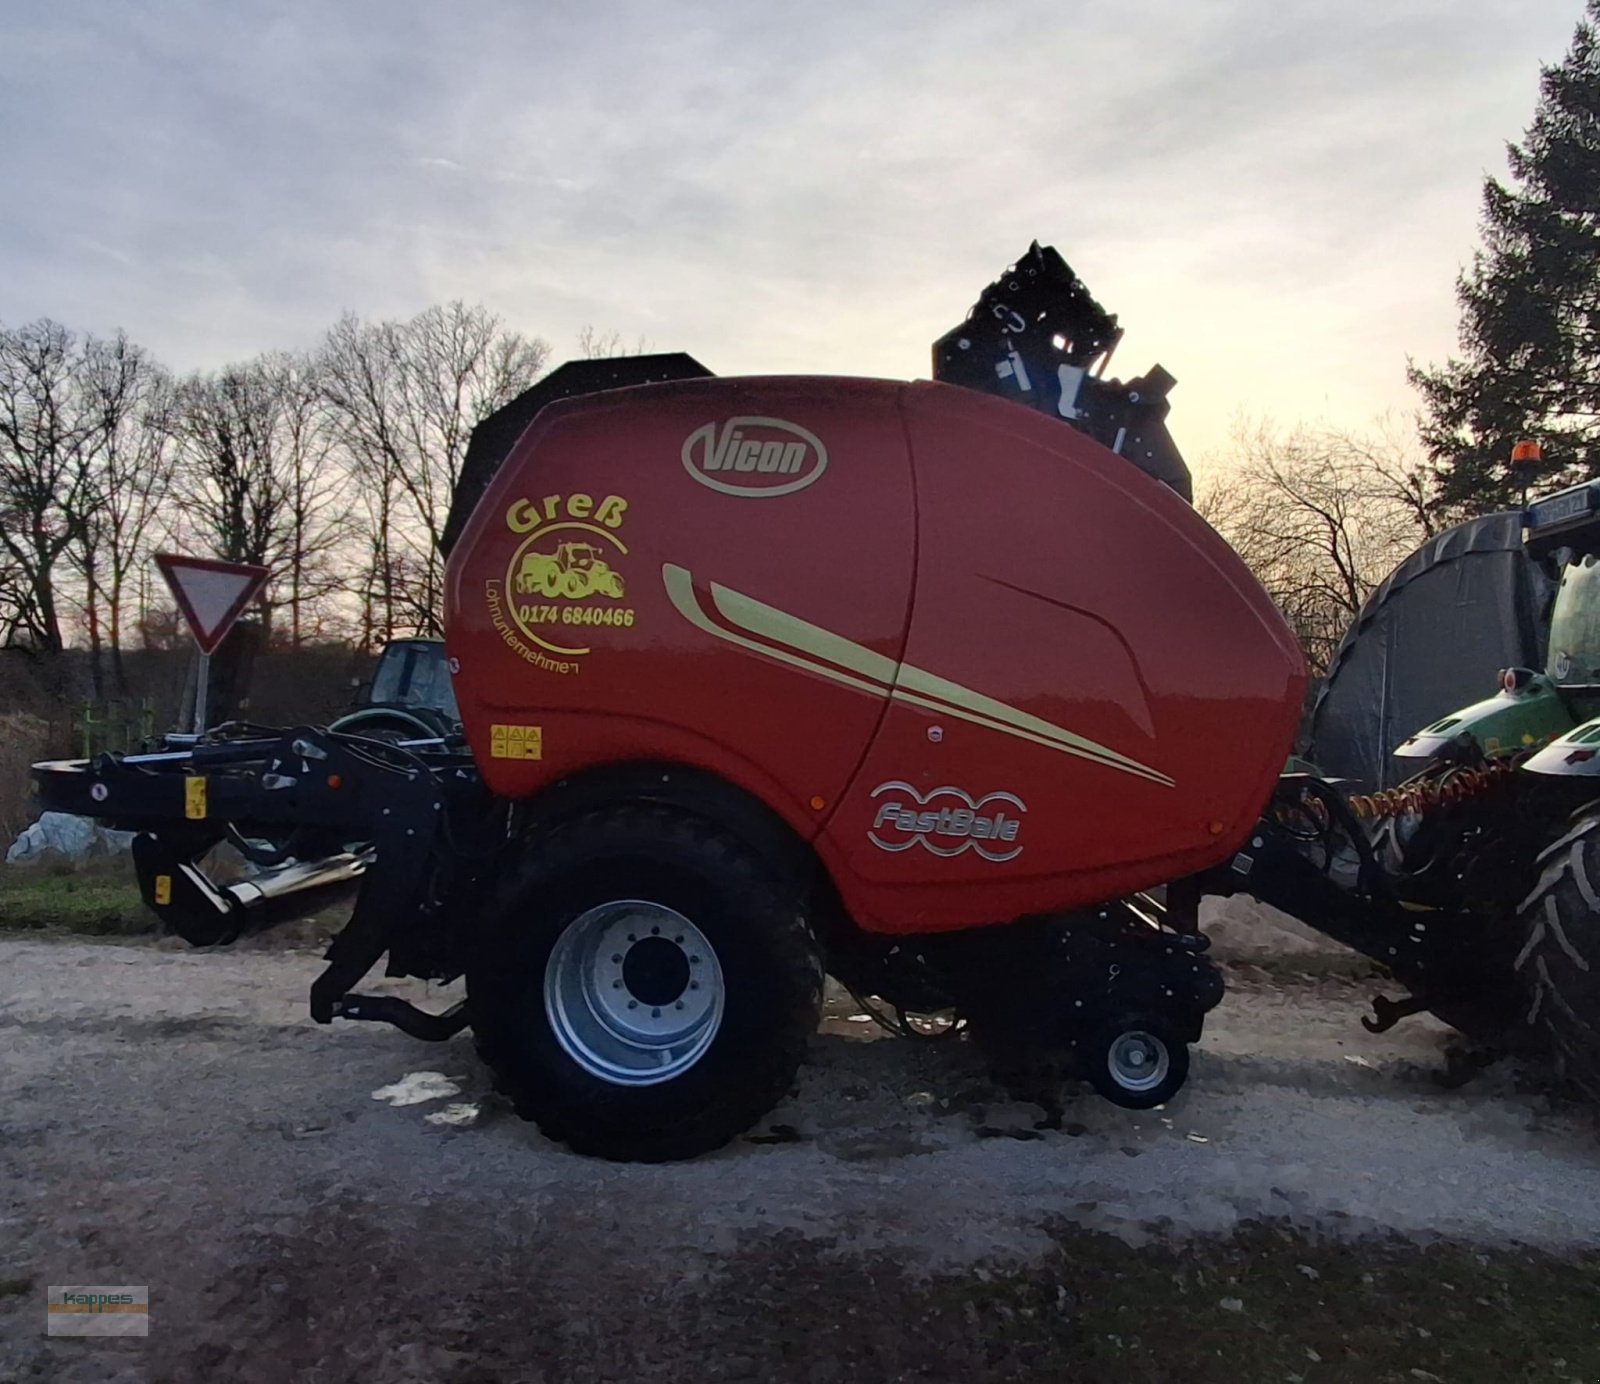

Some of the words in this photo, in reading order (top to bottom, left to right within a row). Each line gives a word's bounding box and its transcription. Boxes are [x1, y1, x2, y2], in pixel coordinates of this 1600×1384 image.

[702, 418, 807, 474] Vicon
[506, 494, 628, 533] Greß
[519, 605, 558, 623] 0174
[562, 607, 635, 627] 6840466
[873, 802, 1021, 842] FastBale
